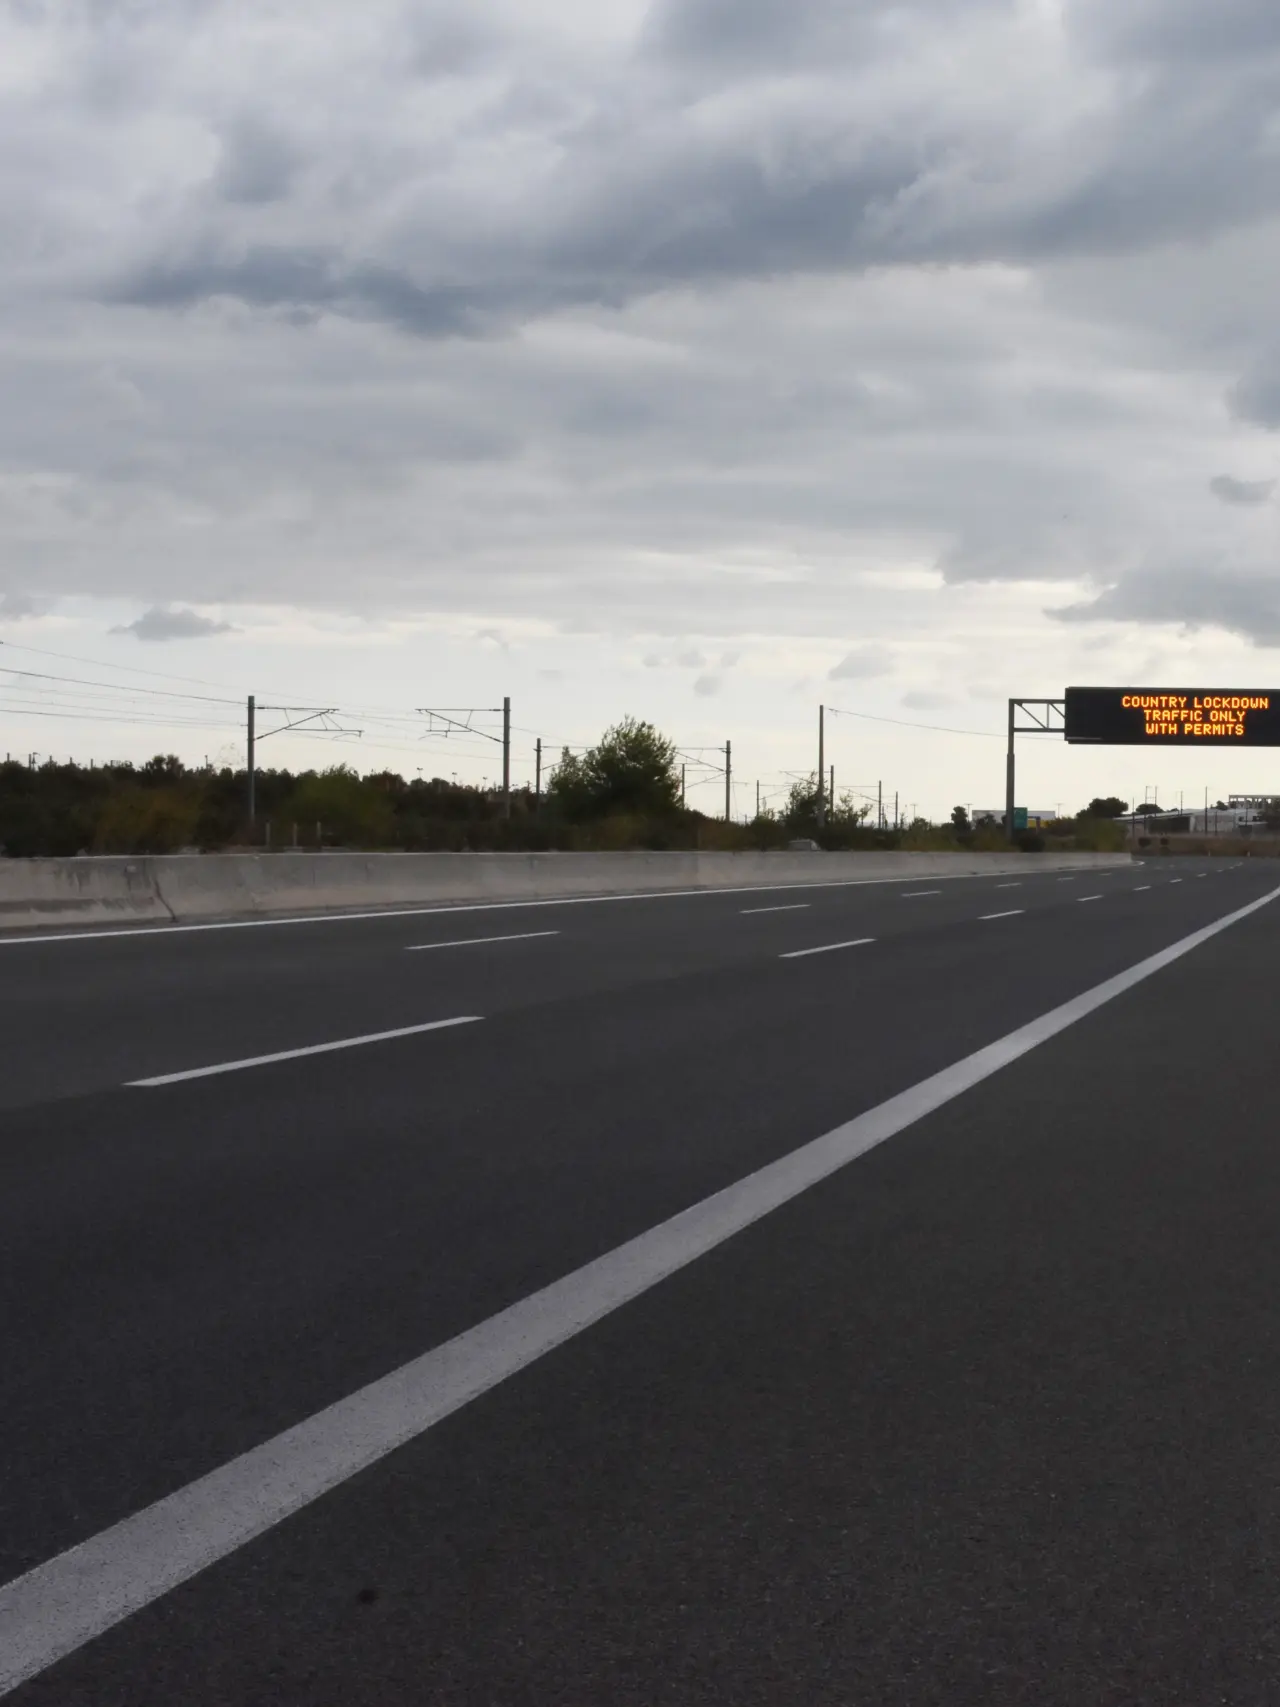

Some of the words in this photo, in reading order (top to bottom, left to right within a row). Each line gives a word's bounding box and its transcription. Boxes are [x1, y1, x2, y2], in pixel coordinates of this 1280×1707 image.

[1121, 695, 1187, 709] COUNTRY
[1193, 697, 1269, 710] LOCKDOWN
[1143, 709, 1203, 722] TRAFFIC
[1209, 710, 1246, 723] ONLY
[1145, 723, 1178, 735] WITH
[1184, 723, 1245, 736] PERMITS
